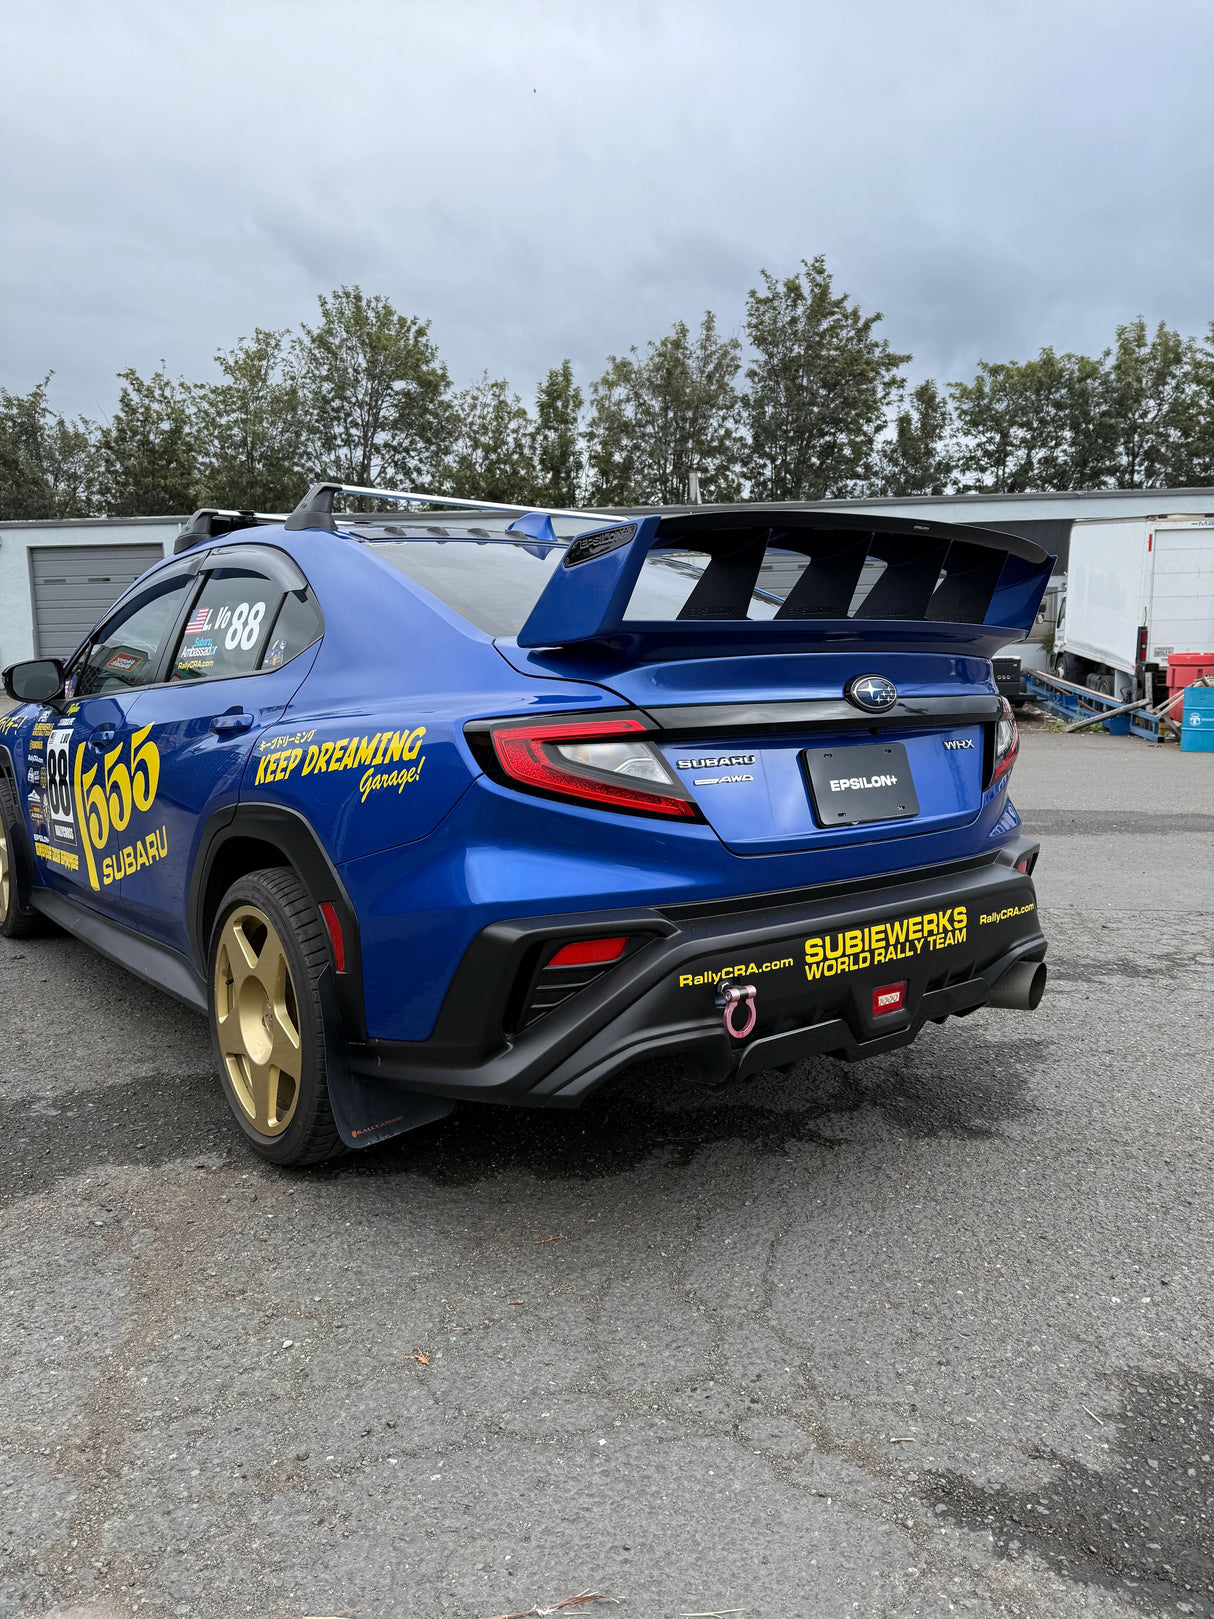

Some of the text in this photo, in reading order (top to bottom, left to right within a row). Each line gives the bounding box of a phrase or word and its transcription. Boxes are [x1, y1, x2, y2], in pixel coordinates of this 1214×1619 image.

[225, 601, 266, 651] 88
[178, 660, 214, 671] RallyCRA.com
[181, 644, 218, 658] Ambassador
[254, 726, 427, 786] KEEP DREAMING
[943, 739, 975, 750] WRX
[677, 755, 756, 770] SUBARU
[48, 749, 71, 817] 88
[359, 756, 426, 803] Garage!
[718, 774, 755, 784] AWD
[829, 774, 898, 792] EPSILON+
[102, 825, 168, 885] SUBARU
[979, 902, 1035, 925] RallyCRA.com
[804, 906, 968, 964] SUBIEWERKS
[804, 928, 967, 981] WORLD RALLY TEAM
[679, 957, 794, 988] RallyCRA.com
